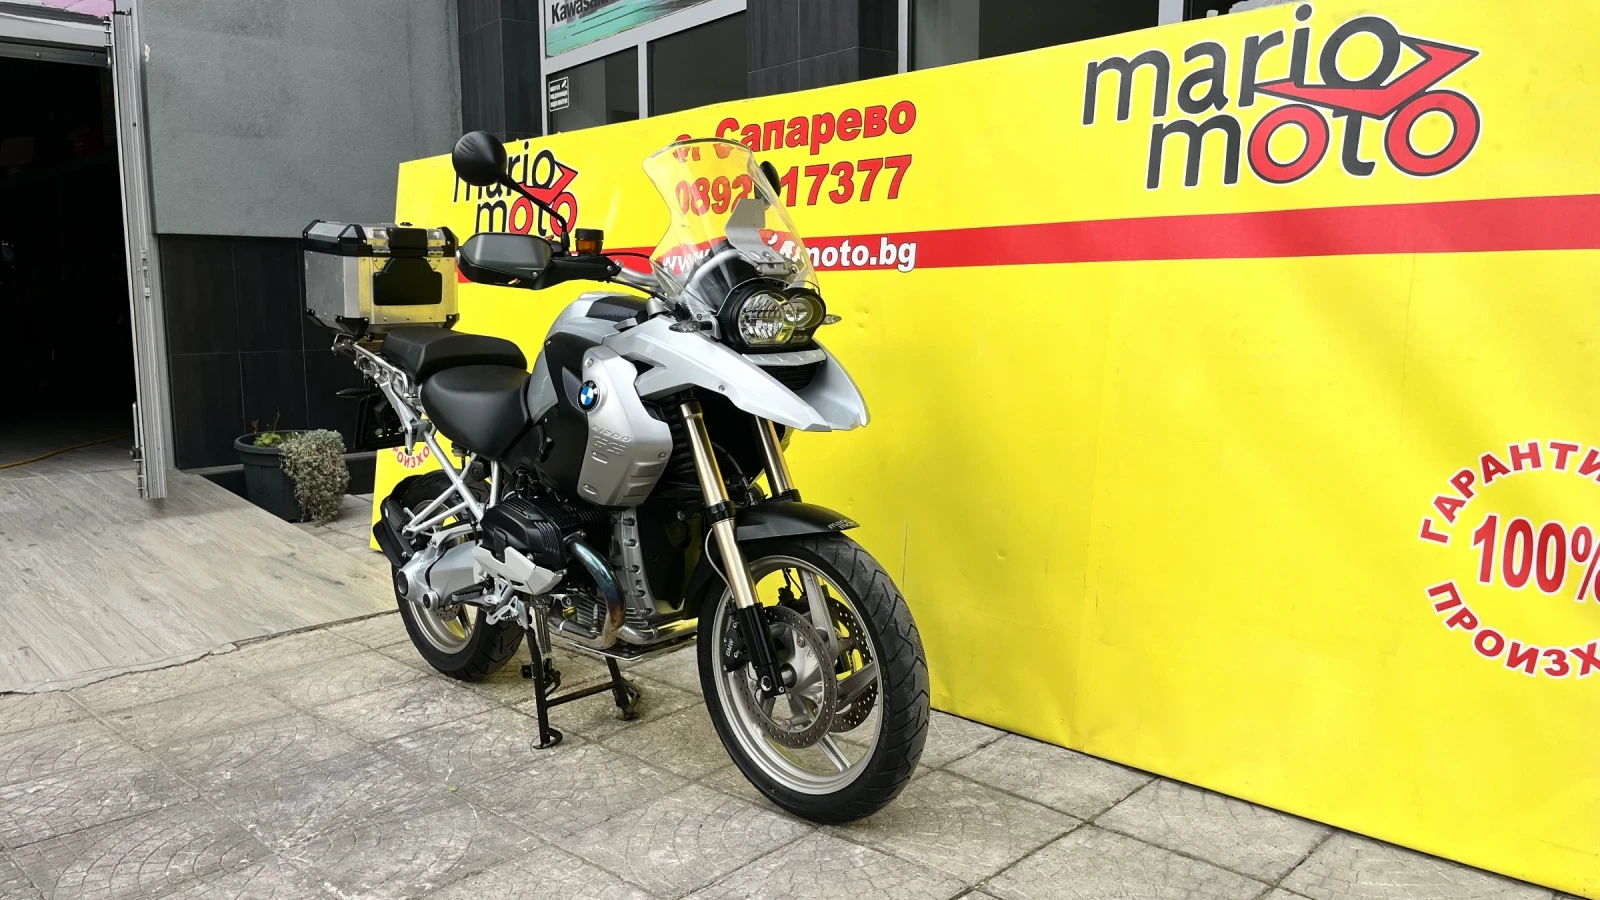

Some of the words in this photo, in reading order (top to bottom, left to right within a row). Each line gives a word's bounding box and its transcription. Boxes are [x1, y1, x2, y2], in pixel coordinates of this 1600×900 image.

[551, 0, 609, 24] Kawasa
[1082, 4, 1401, 125] mario
[715, 100, 917, 159] Сапарево
[1146, 90, 1480, 189] moto
[674, 154, 912, 217] 089217377
